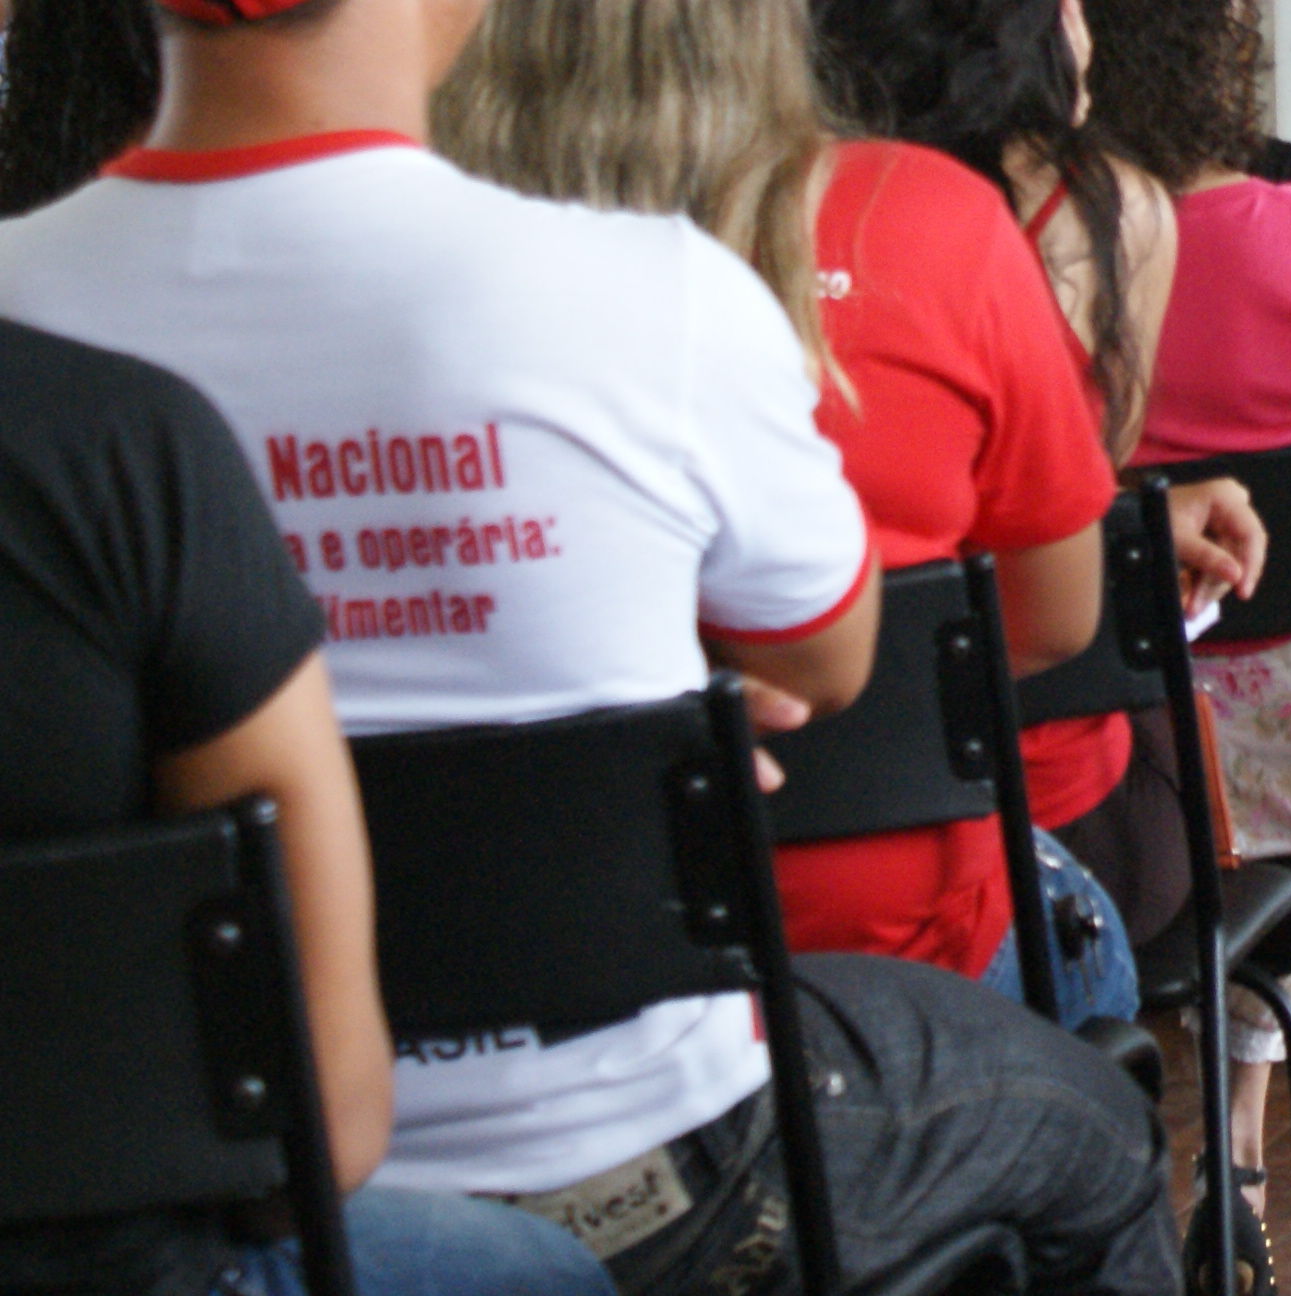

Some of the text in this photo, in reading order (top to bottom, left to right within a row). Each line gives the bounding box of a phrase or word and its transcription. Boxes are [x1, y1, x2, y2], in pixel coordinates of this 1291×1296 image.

[265, 421, 505, 503] Nacional
[319, 529, 346, 572] e
[314, 590, 495, 642] imentar
